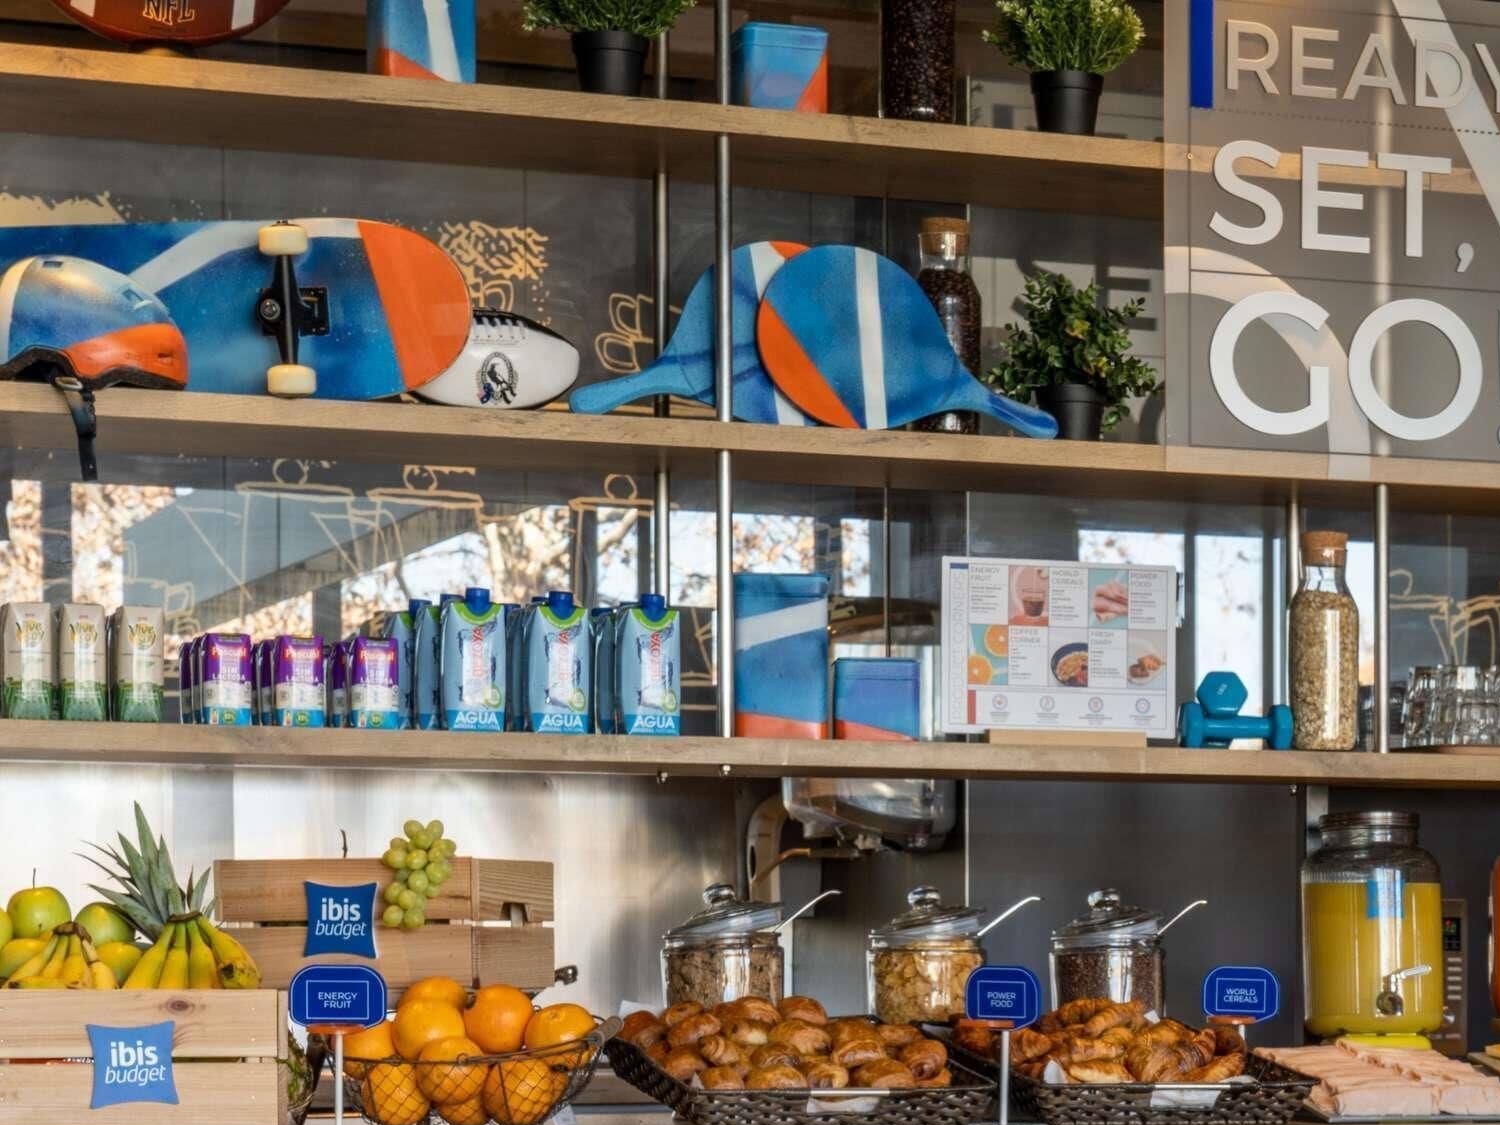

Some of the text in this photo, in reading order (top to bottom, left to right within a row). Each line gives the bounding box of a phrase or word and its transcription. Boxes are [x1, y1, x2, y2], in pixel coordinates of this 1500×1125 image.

[142, 0, 195, 26] NFL
[1208, 139, 1475, 273] SET,
[454, 711, 499, 724] AGUA
[540, 714, 584, 727] AGUA
[633, 715, 676, 729] AGUA
[321, 897, 362, 922] ibis
[314, 919, 368, 940] budget
[318, 991, 359, 1000] ENERGY
[986, 991, 1017, 1000] POWER
[1225, 987, 1257, 996] WORLD
[323, 1000, 353, 1009] FRUIT
[990, 1000, 1014, 1008] FOOD
[1223, 995, 1259, 1004] CEREALS
[110, 1040, 160, 1068] ibis
[104, 1064, 167, 1087] budget
